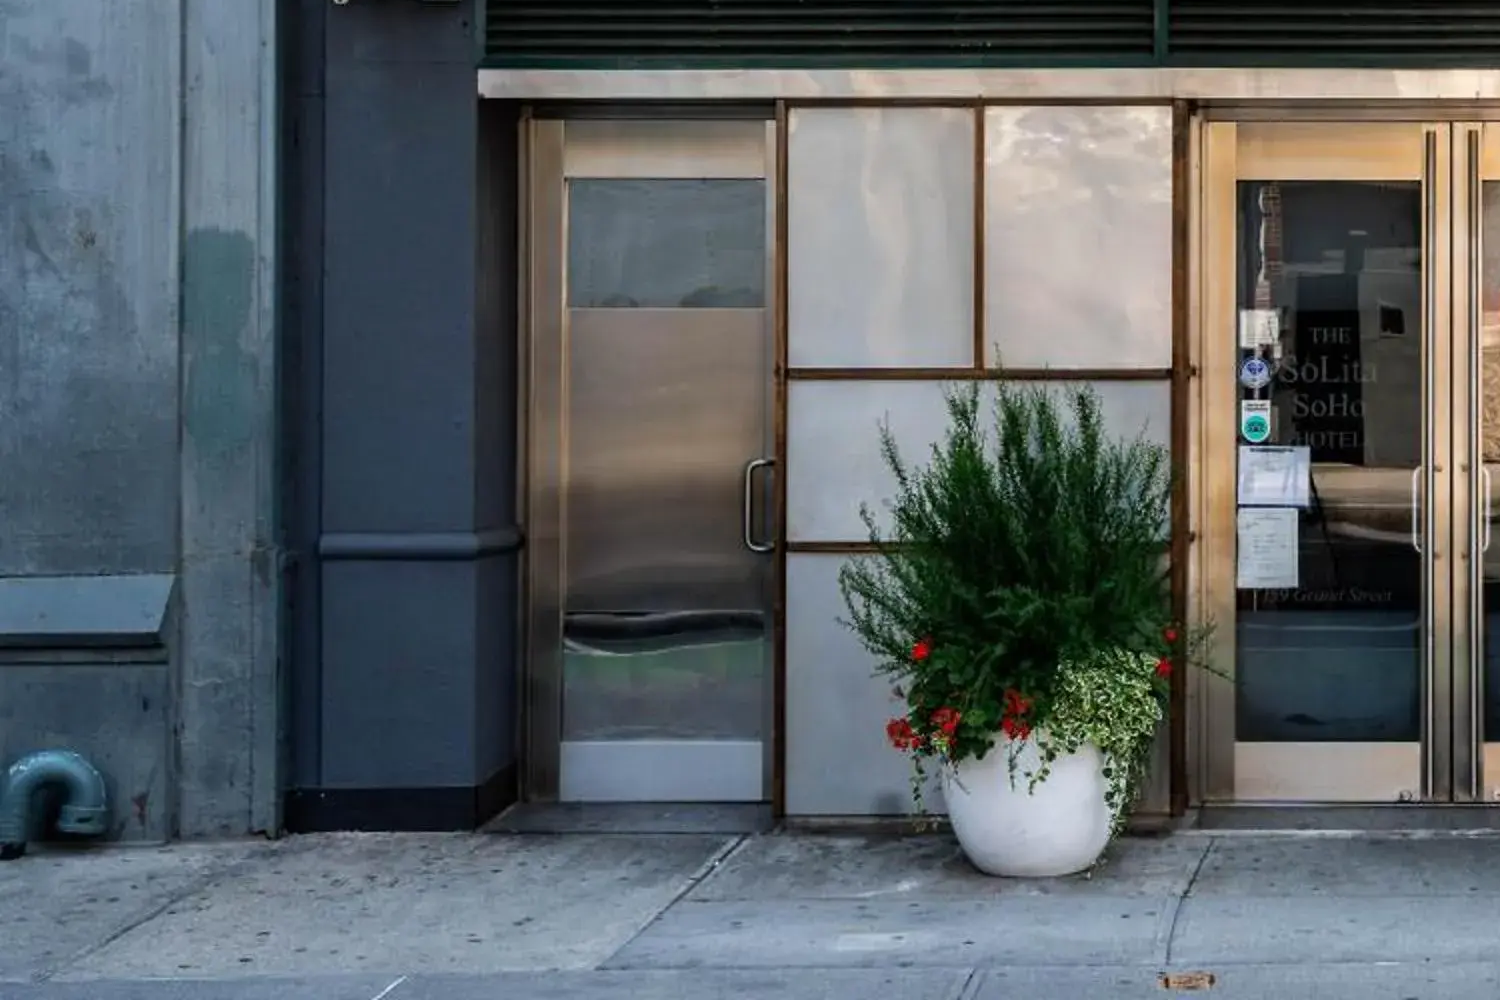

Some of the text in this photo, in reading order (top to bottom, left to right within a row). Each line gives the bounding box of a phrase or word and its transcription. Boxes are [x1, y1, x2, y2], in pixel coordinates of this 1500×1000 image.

[1307, 326, 1353, 345] THE
[1277, 352, 1377, 384] SoLita
[1292, 392, 1366, 418] SoHo
